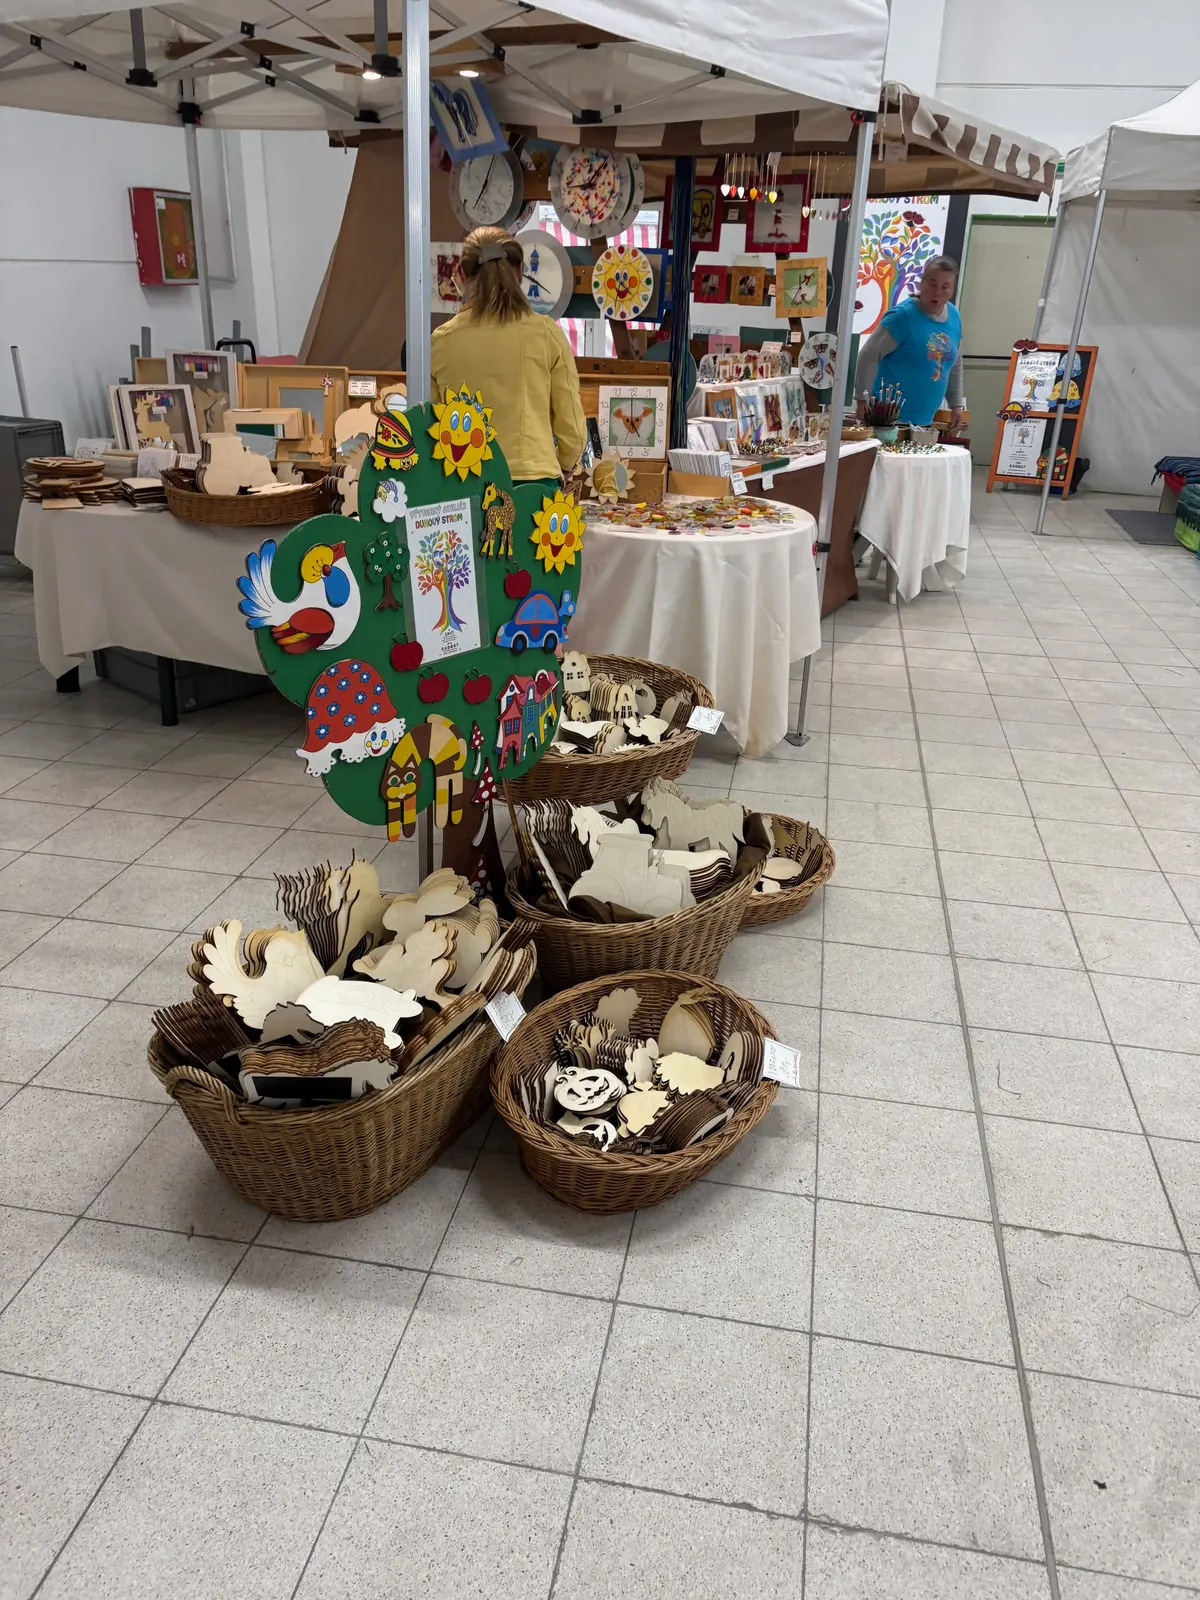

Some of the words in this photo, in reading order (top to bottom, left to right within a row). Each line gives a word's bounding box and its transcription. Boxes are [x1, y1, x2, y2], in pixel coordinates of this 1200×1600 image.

[628, 387, 638, 397] 12
[657, 402, 665, 412] 2
[599, 418, 606, 427] 9
[657, 419, 664, 427] 3
[441, 512, 463, 524] STROM
